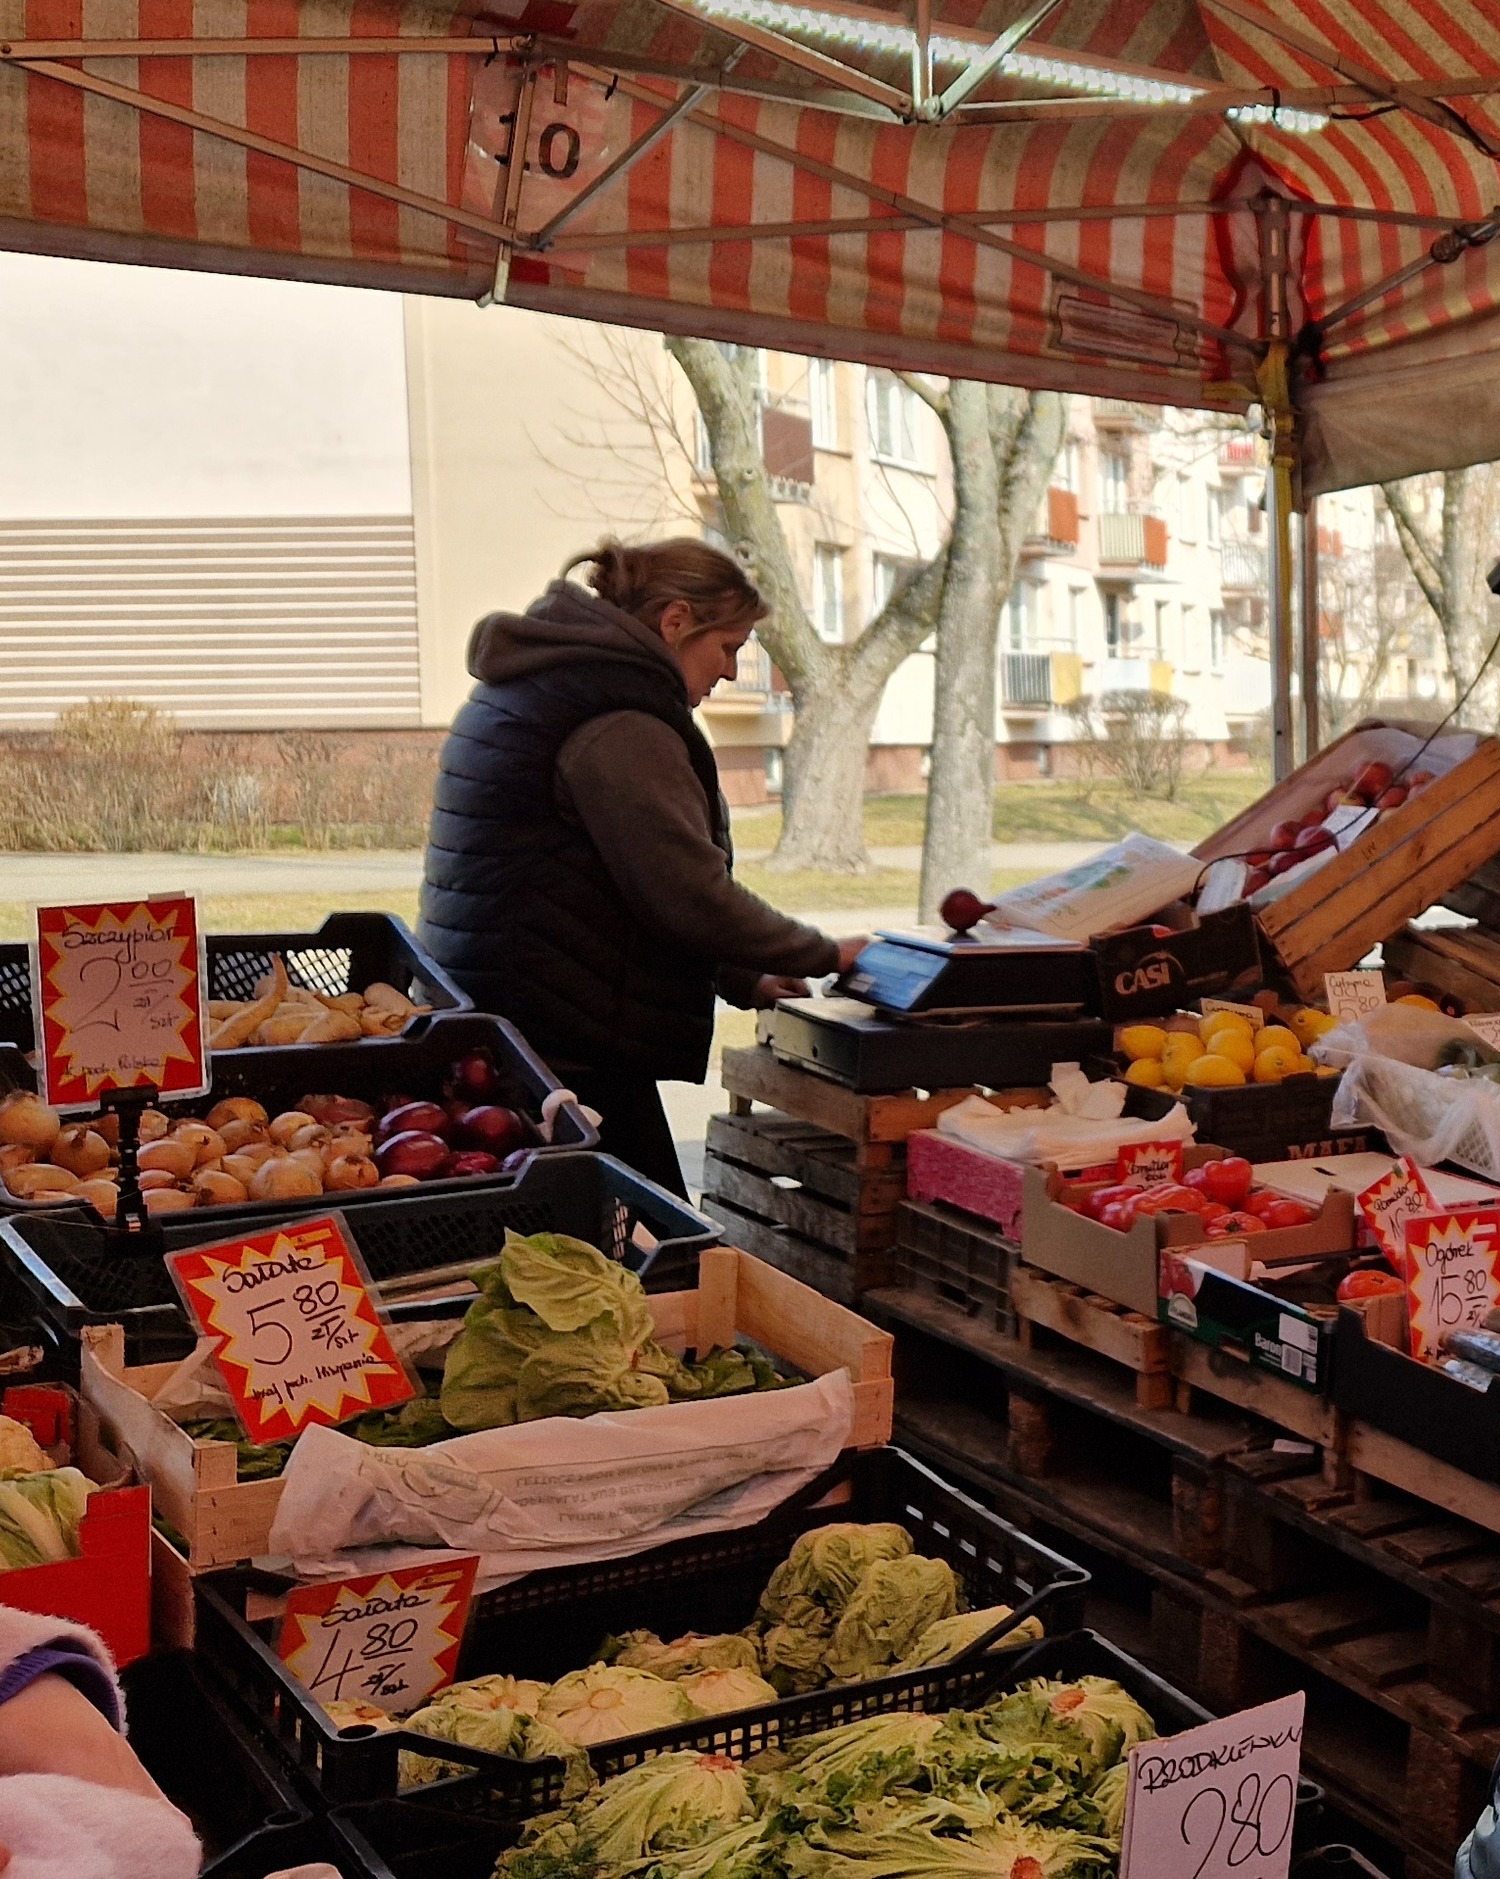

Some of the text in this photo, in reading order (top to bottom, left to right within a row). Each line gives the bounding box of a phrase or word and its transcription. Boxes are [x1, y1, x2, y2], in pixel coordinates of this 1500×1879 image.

[61, 922, 176, 964] Szczypior
[1115, 961, 1171, 995] CASI
[1425, 1242, 1475, 1274] Ogórek
